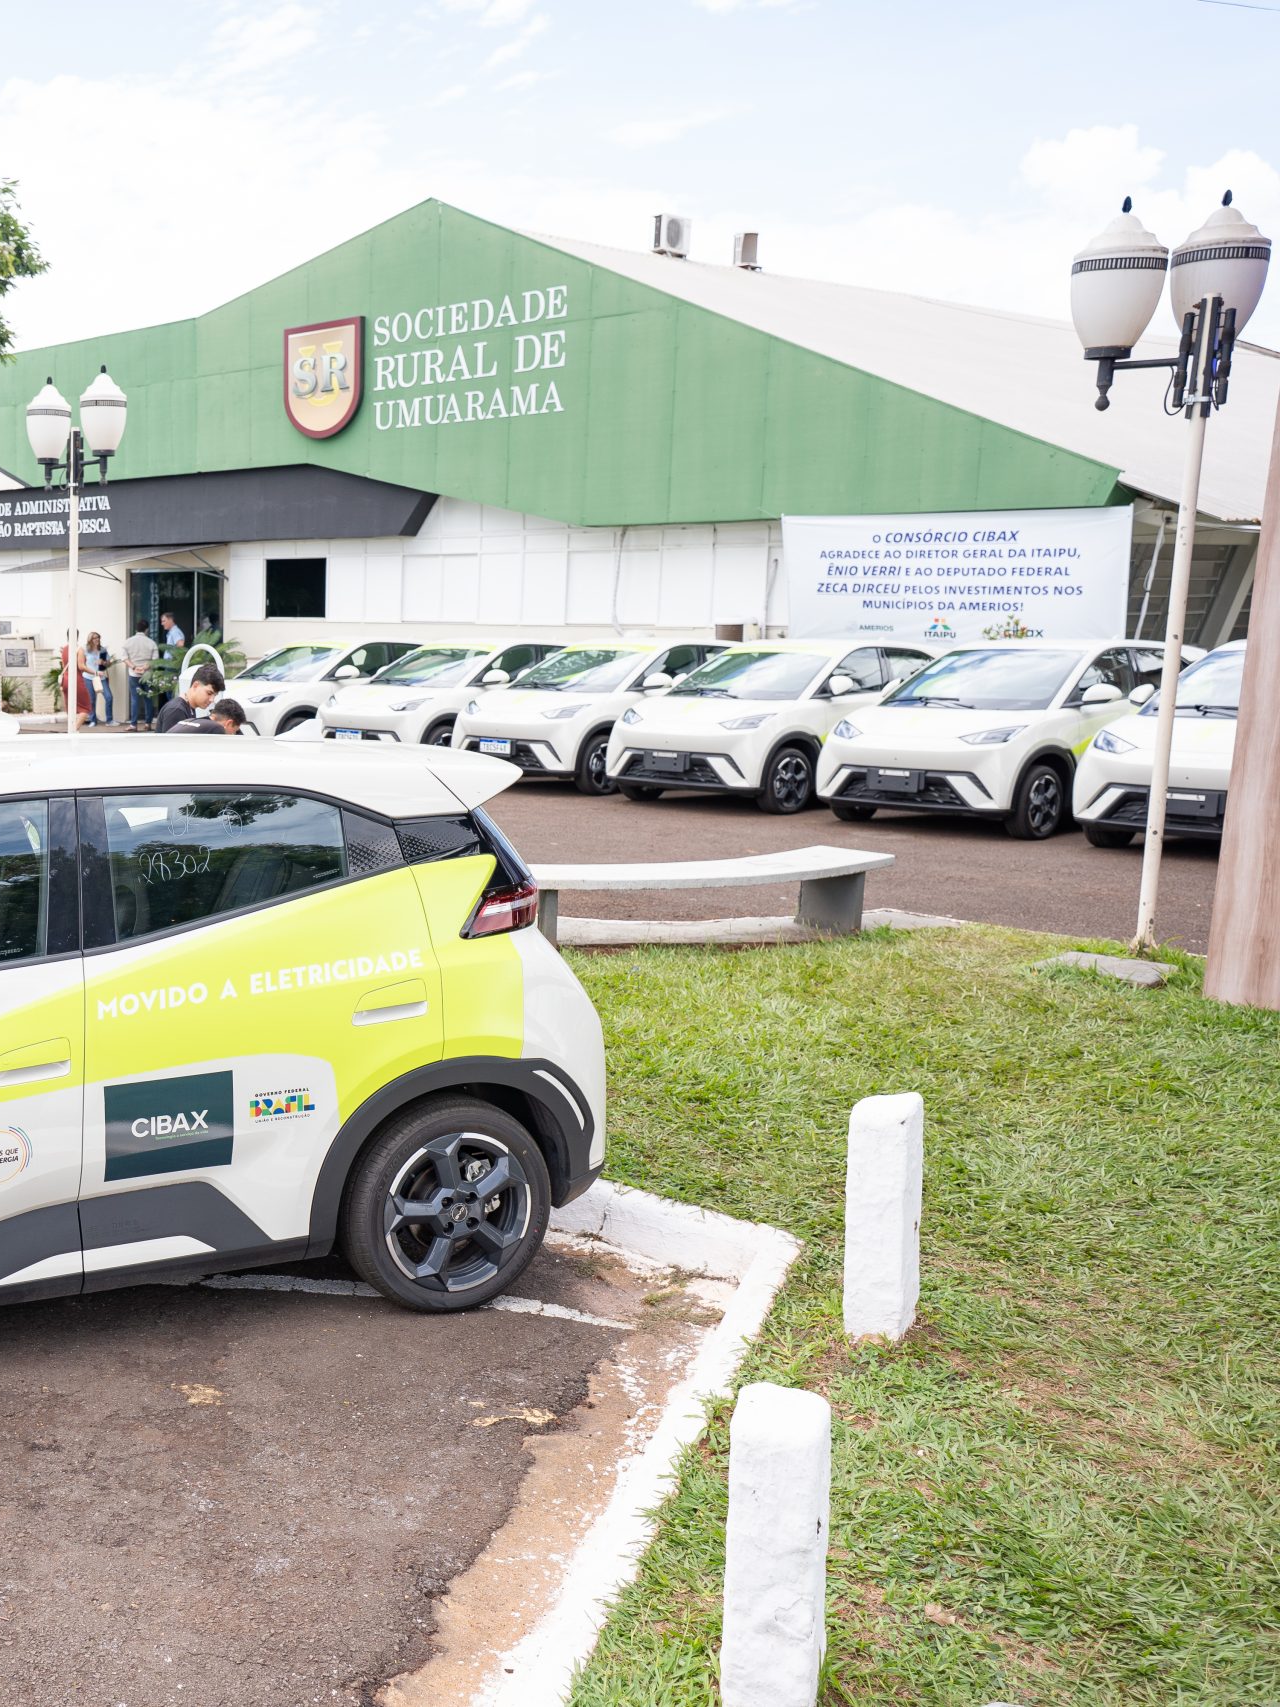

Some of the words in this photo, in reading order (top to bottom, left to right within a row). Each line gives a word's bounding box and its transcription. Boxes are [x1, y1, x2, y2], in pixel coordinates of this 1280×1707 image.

[373, 285, 568, 347] SOCIEDADE
[373, 342, 498, 391] RURAL
[513, 330, 566, 373] DE
[292, 352, 350, 398] SR
[373, 381, 564, 430] UMUARAMA
[14, 495, 111, 515] ADMINISTATIVA
[14, 520, 65, 537] BAPTISTA
[873, 534, 881, 543] O
[885, 528, 968, 543] CONSÓRCIO
[973, 530, 1019, 542] CIBAX
[820, 550, 880, 559] AGRADECE
[884, 550, 901, 559] AO
[906, 549, 958, 559] DIRETOR
[963, 549, 1004, 558] GERAL
[1008, 548, 1026, 558] DA
[1031, 547, 1081, 559] ITAIPU,
[827, 562, 858, 576] ÊNIO
[863, 566, 901, 576] VERRI
[905, 567, 910, 576] E
[914, 567, 932, 576] AO
[937, 567, 1007, 576] DEPUTADO
[1012, 567, 1070, 576] FEDERAL
[817, 583, 848, 593] ZECA
[852, 583, 900, 594] DIRCEU
[904, 585, 940, 594] PELOS
[944, 586, 1049, 595] INVESTIMENTOS
[1053, 586, 1083, 595] NOS
[862, 598, 934, 610] MUNICÍPIOS
[938, 602, 955, 610] DA
[959, 602, 1024, 612] AMERIOS!
[924, 631, 956, 639] ITAIPU
[97, 982, 208, 1020] MOVIDO
[220, 980, 237, 1000] A
[249, 949, 424, 995] ELETRICIDADE
[255, 1090, 282, 1098] GOVERNO
[249, 1093, 315, 1117] BRASIL
[131, 1109, 209, 1138] CIBAX
[4, 1147, 19, 1157] QUE
